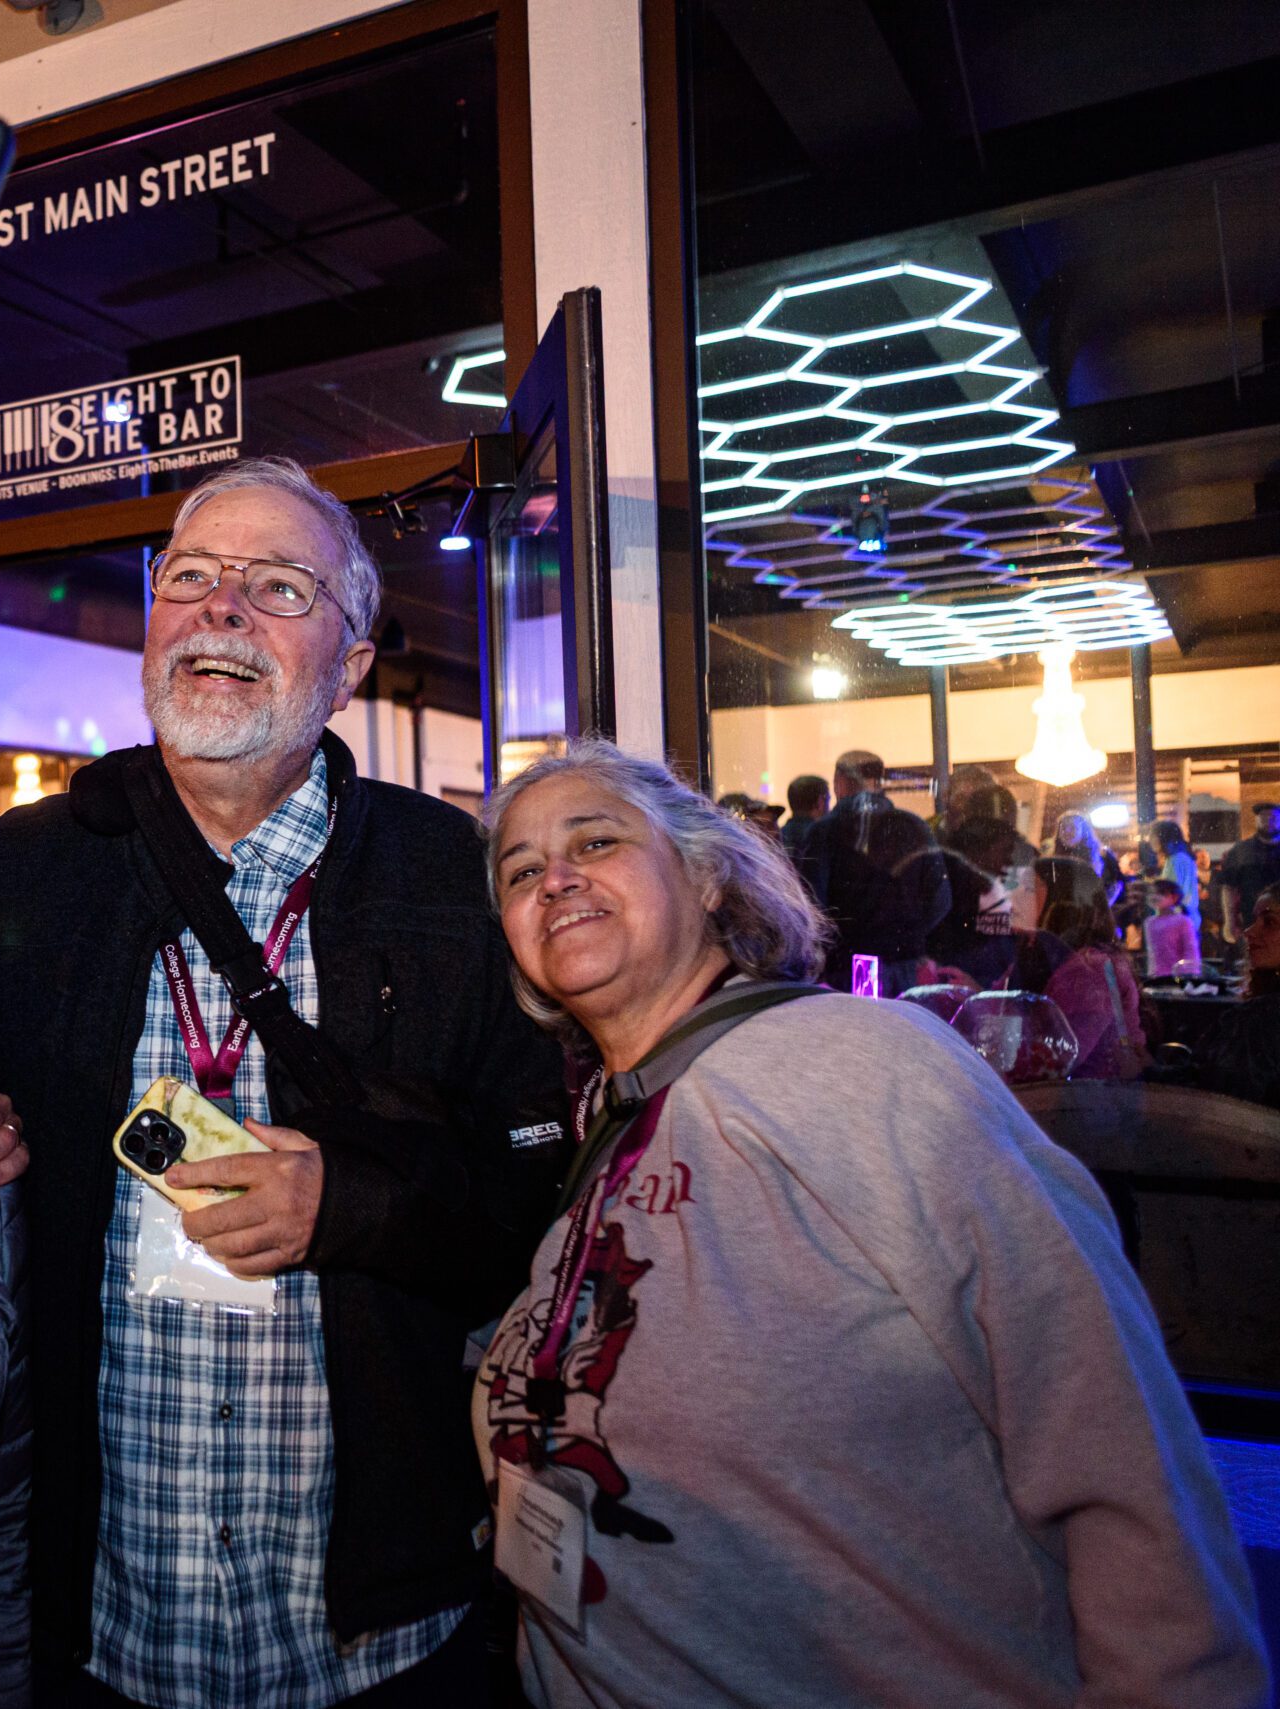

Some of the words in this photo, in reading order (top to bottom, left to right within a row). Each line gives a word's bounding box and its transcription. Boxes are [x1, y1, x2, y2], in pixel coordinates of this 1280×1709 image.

[43, 174, 129, 235] MAIN
[138, 131, 277, 208] STREET
[81, 376, 179, 426] EIGHT
[189, 366, 232, 405] TO
[82, 417, 144, 459] THE
[157, 402, 225, 446] BAR
[15, 478, 51, 498] VENUE
[57, 468, 118, 491] BOOKINGS:
[119, 445, 240, 480] EightToTheBar.Events
[164, 943, 181, 979] College
[174, 978, 201, 1050] Homecoming
[575, 1096, 591, 1142] Homecom
